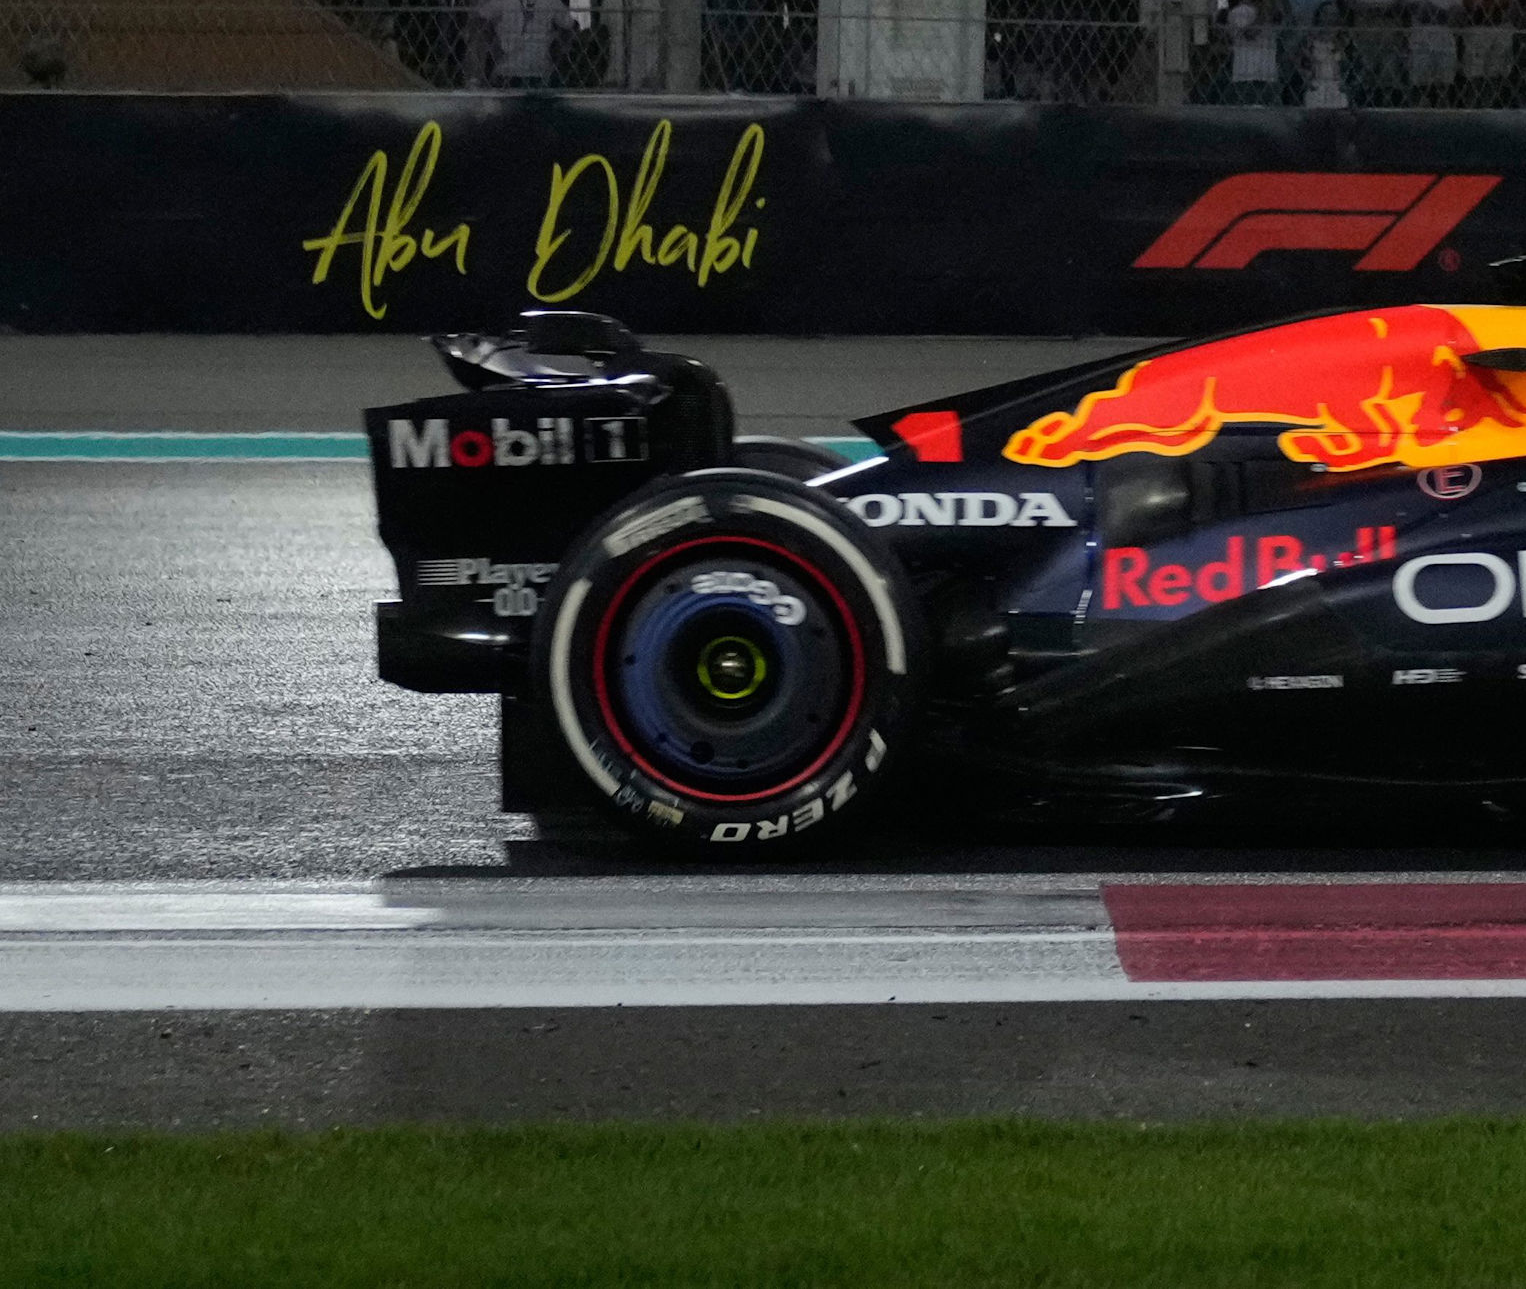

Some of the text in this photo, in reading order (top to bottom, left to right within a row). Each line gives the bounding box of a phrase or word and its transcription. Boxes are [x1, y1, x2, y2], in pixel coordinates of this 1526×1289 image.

[302, 118, 767, 320] Abu Dhabi
[387, 416, 576, 469] Mobil
[835, 491, 1079, 528] ONDA
[1100, 535, 1245, 611] Red
